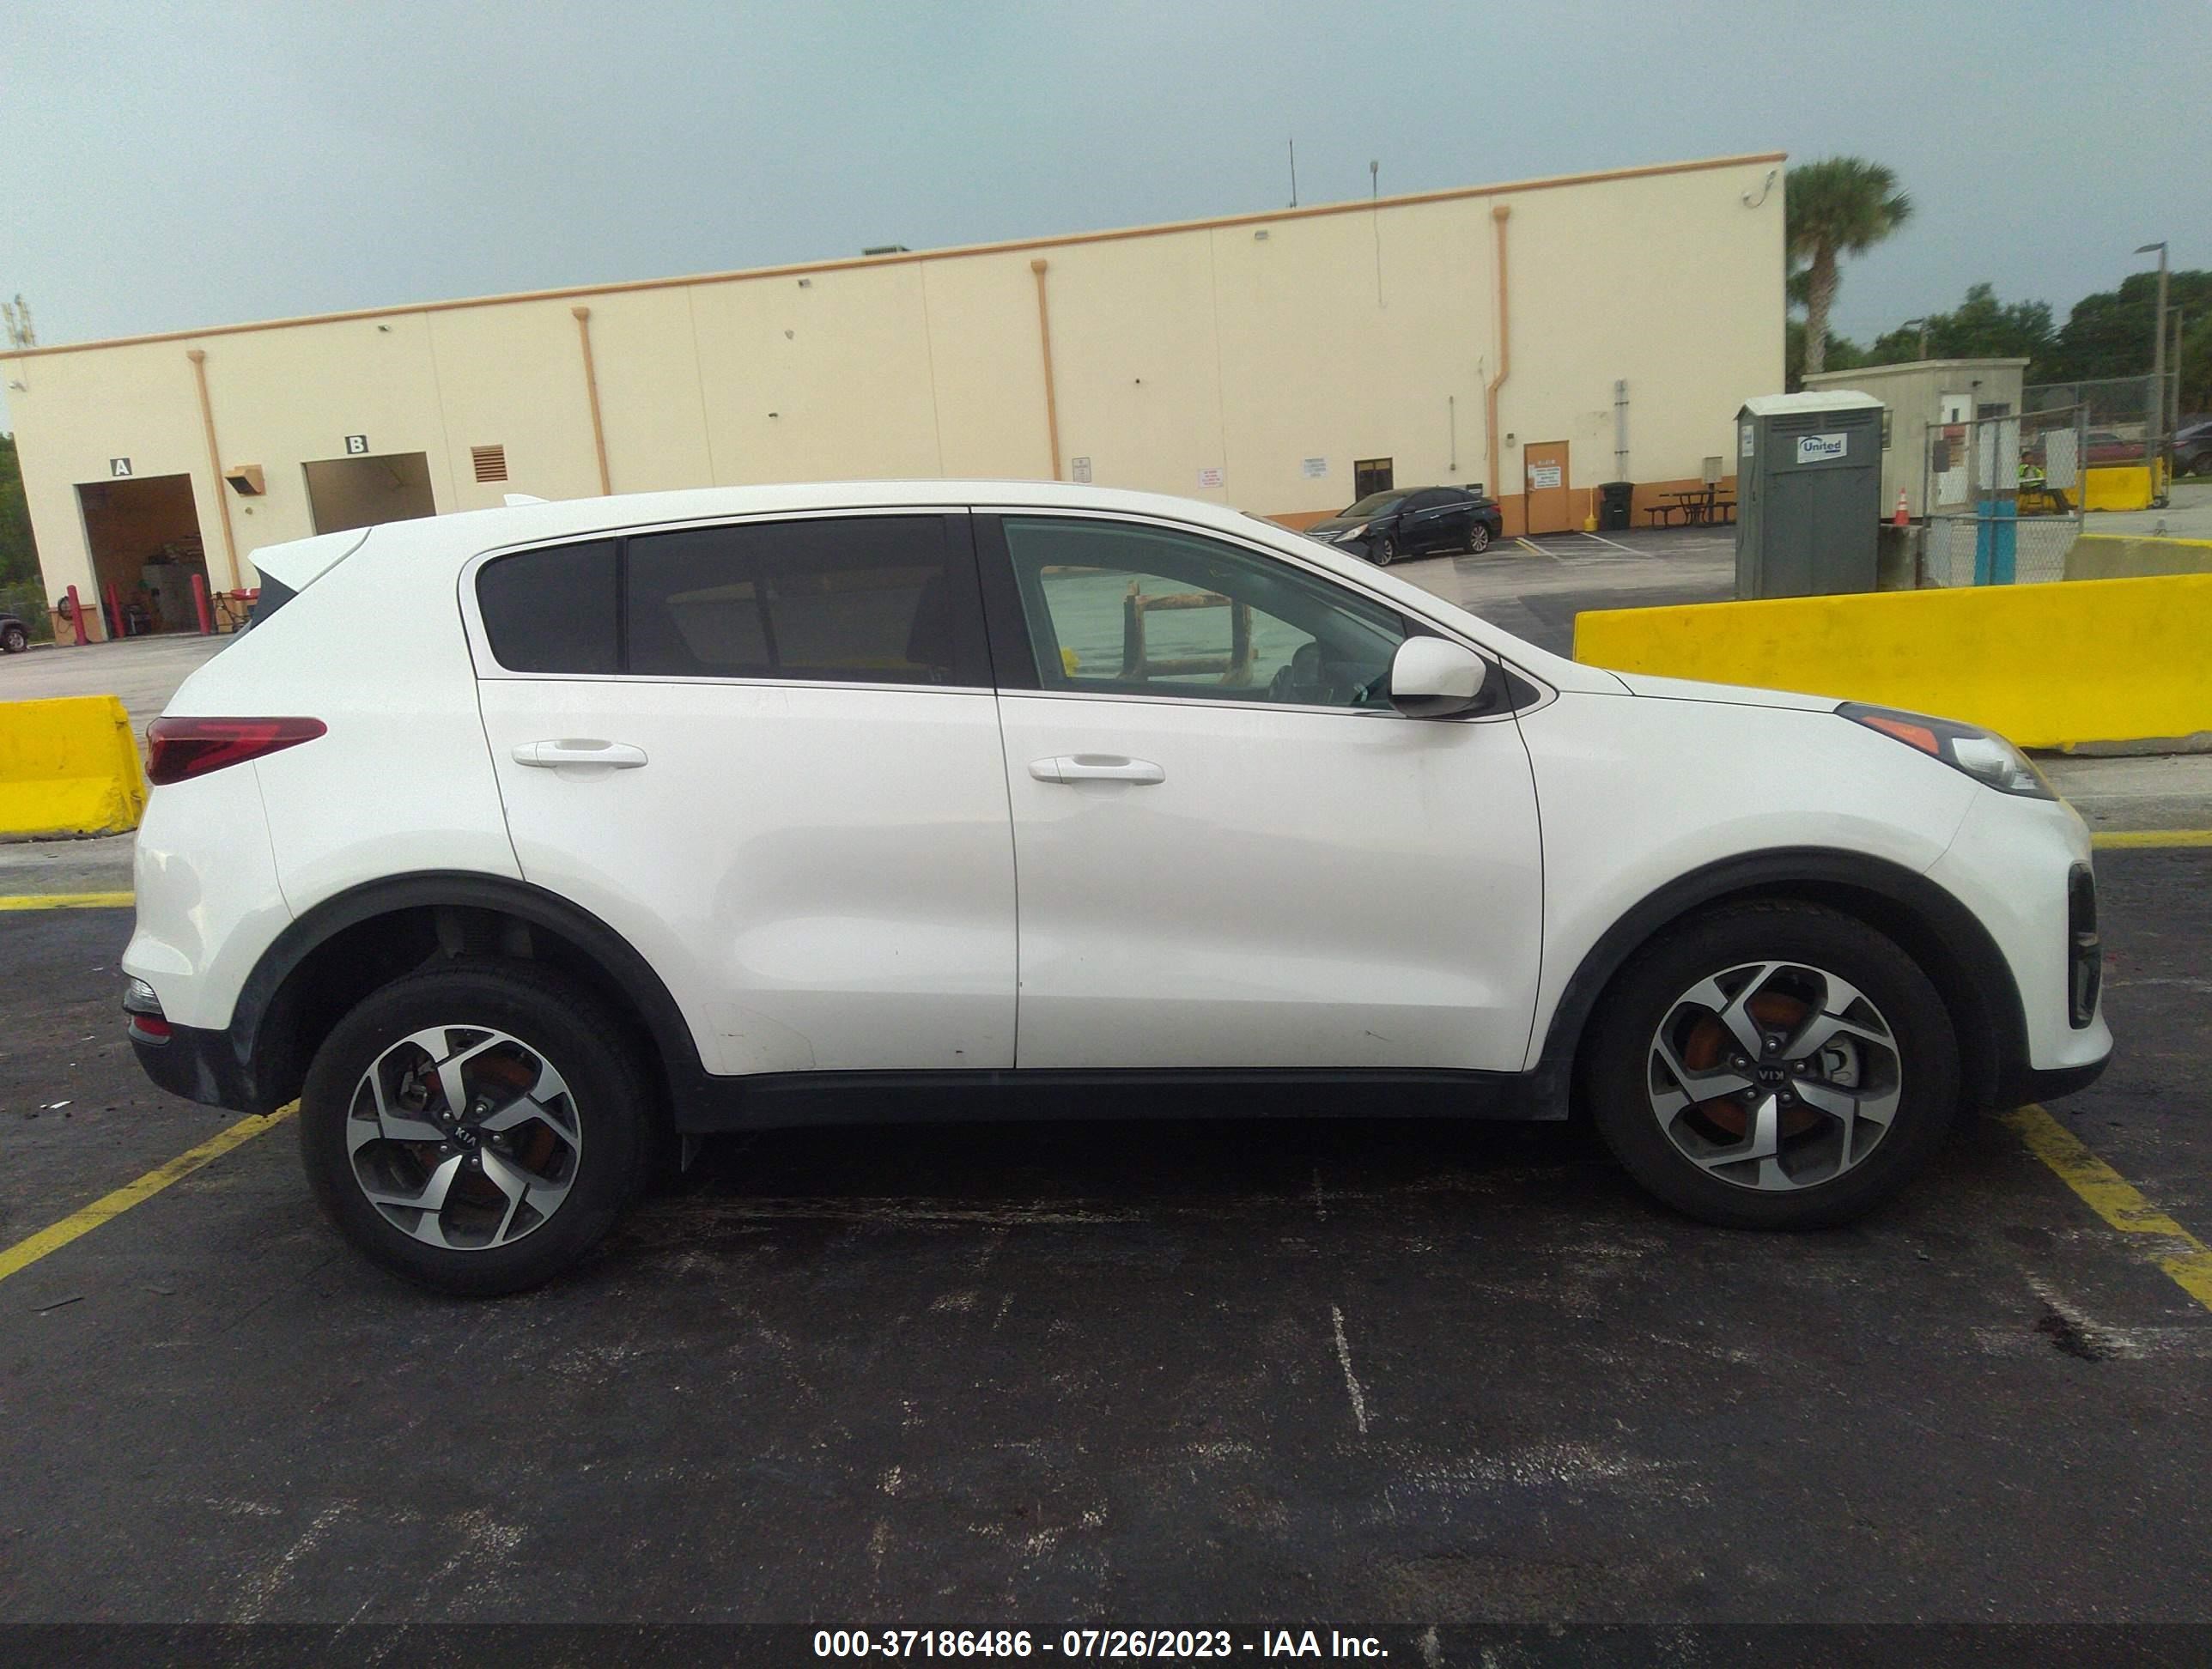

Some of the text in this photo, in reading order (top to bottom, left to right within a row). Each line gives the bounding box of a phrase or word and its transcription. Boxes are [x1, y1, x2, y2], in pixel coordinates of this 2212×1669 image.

[349, 436, 364, 452] B
[1803, 440, 1842, 452] United
[115, 458, 130, 476] A
[1759, 1070, 1785, 1081] KIA
[455, 1126, 477, 1147] KIA
